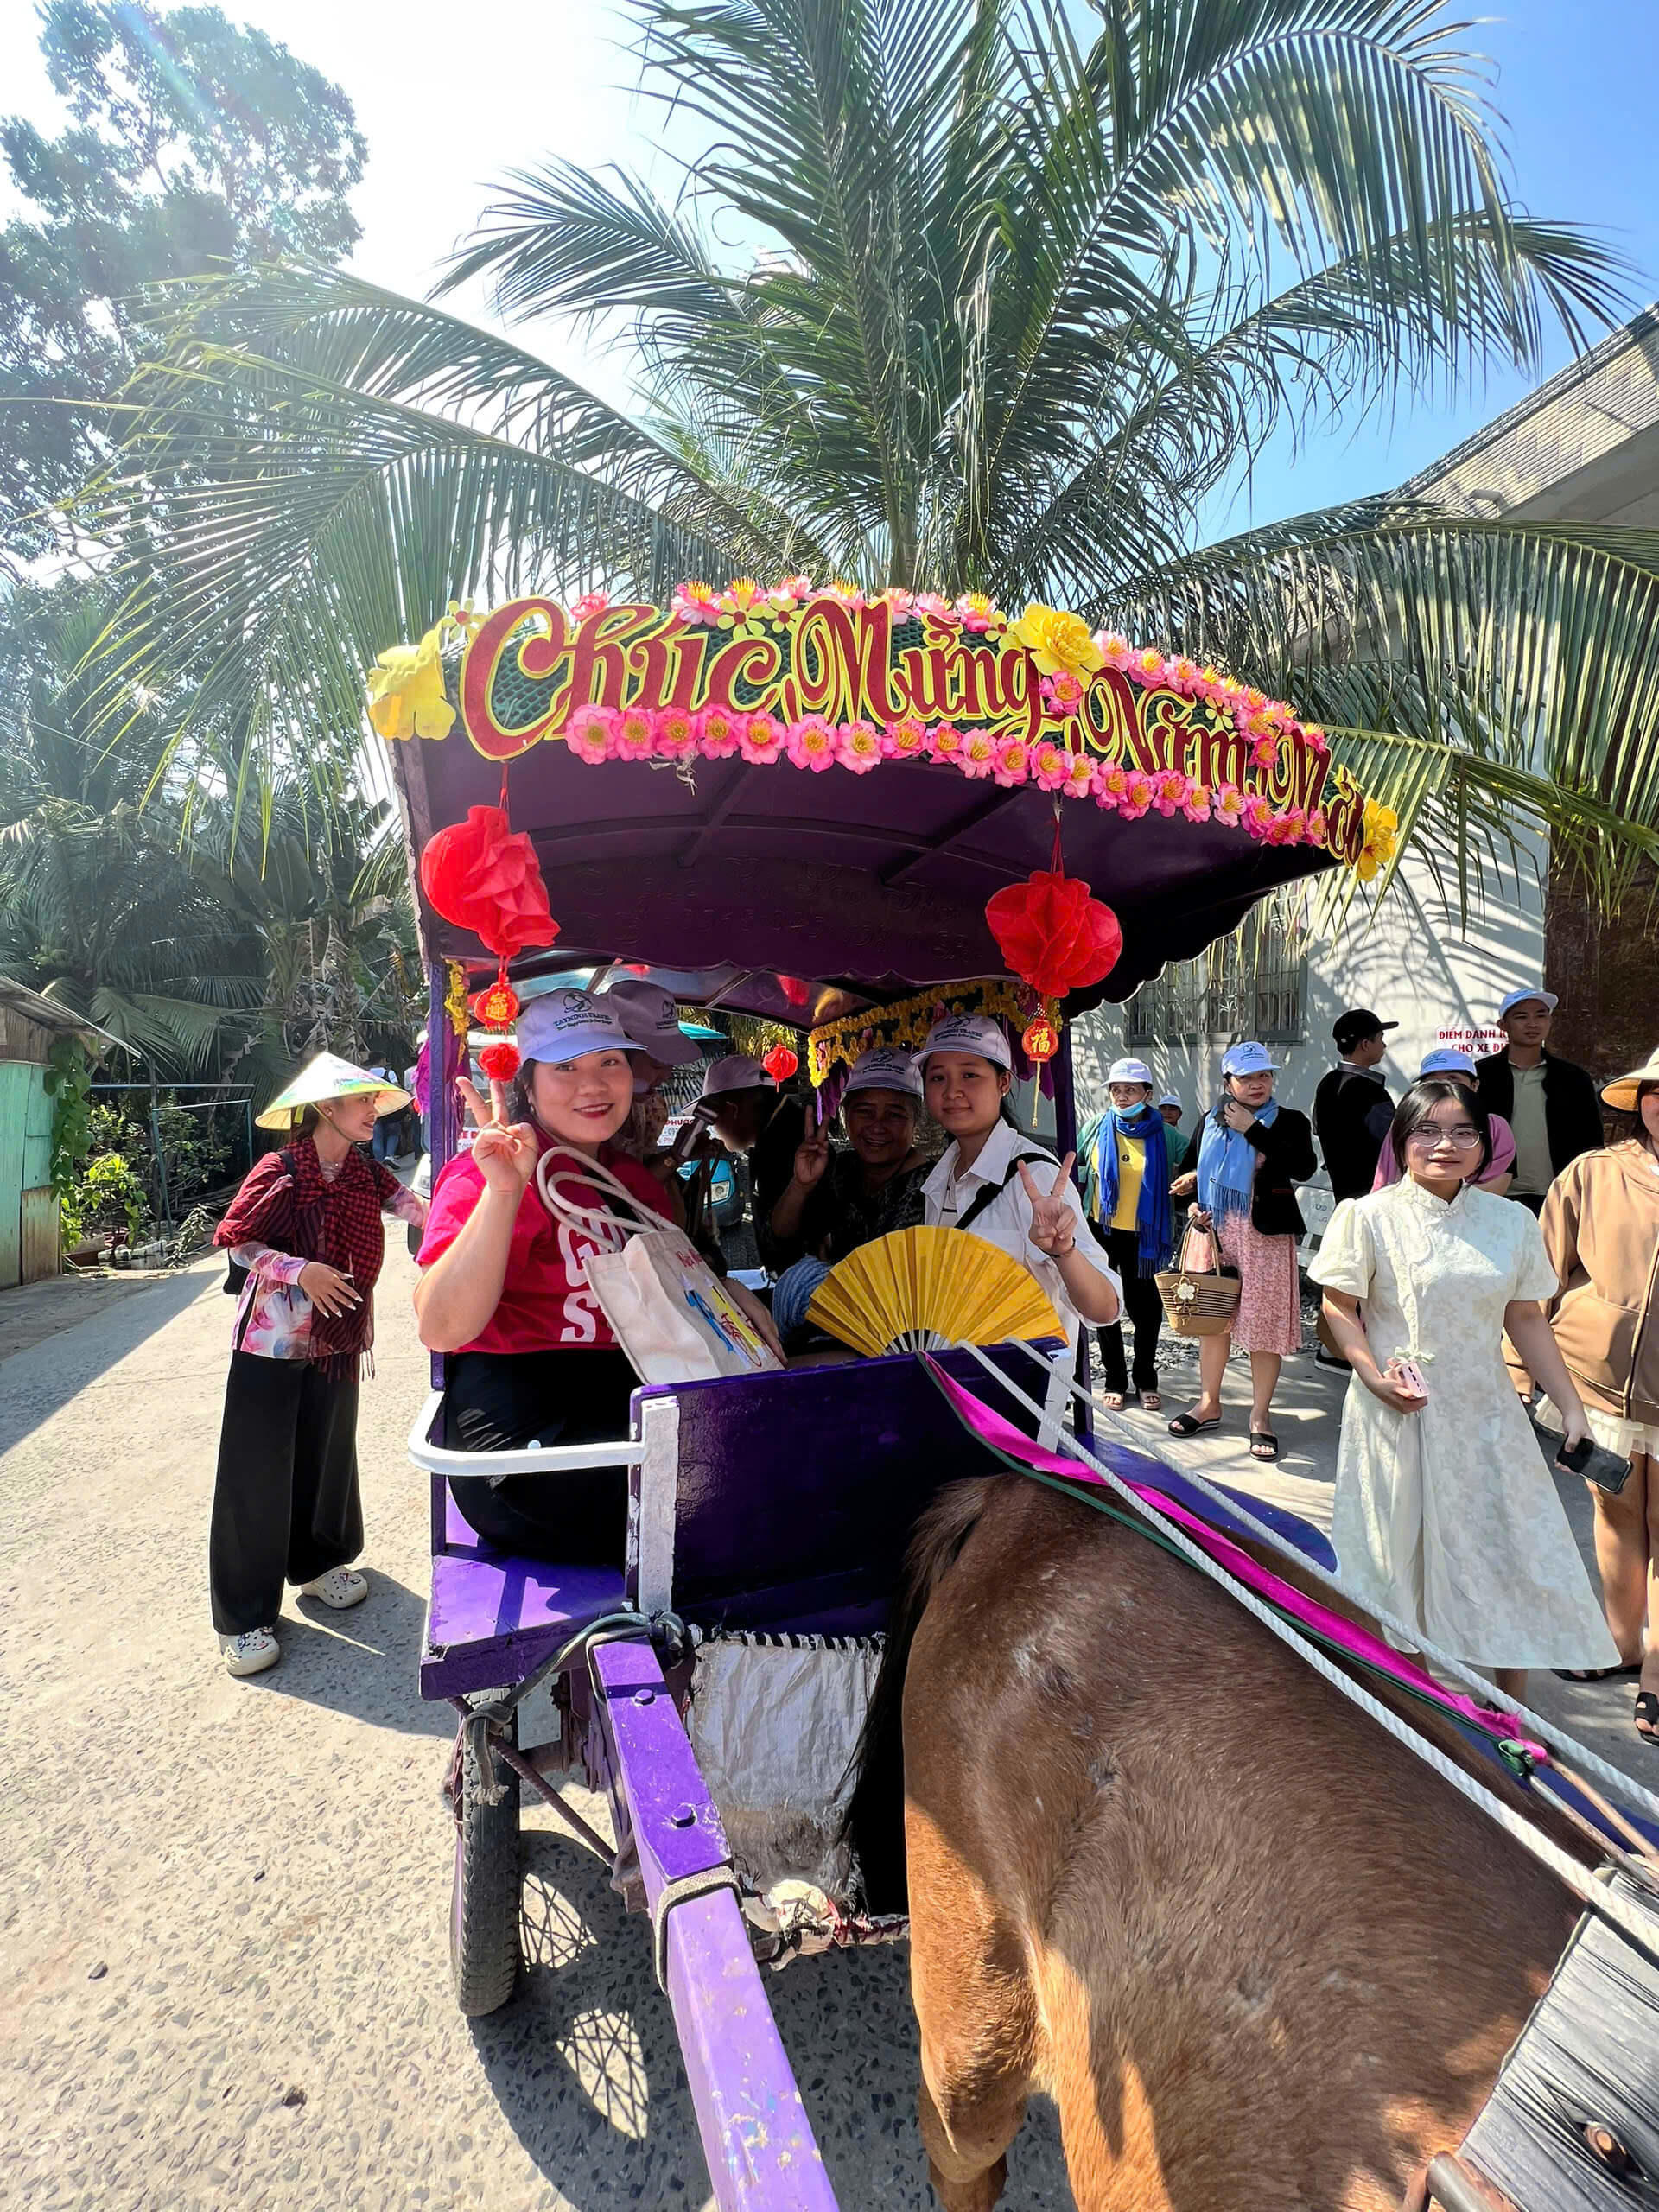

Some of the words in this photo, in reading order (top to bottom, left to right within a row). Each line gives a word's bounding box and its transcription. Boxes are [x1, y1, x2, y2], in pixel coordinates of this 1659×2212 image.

[461, 595, 782, 761] Chúc
[1031, 1027, 1050, 1053] 福
[1477, 1043, 1489, 1052] XE
